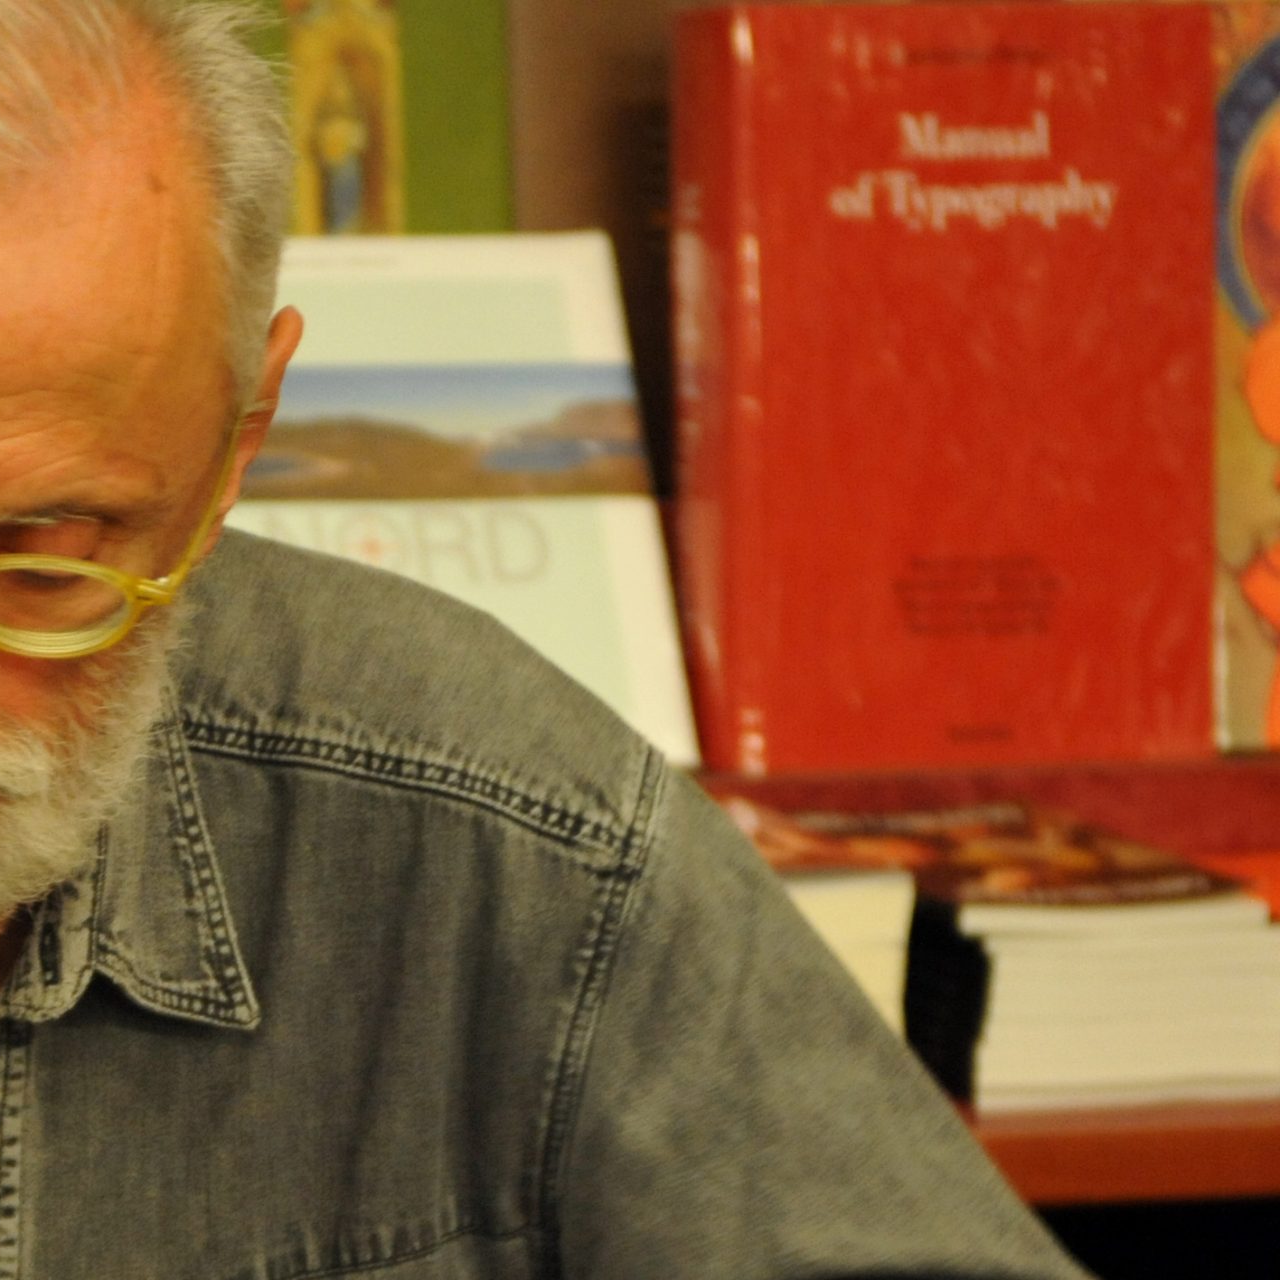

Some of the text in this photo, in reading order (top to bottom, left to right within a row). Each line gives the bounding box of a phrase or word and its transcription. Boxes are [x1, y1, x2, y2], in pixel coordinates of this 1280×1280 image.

[898, 113, 1050, 160] Manual
[828, 165, 1115, 230] of Typography
